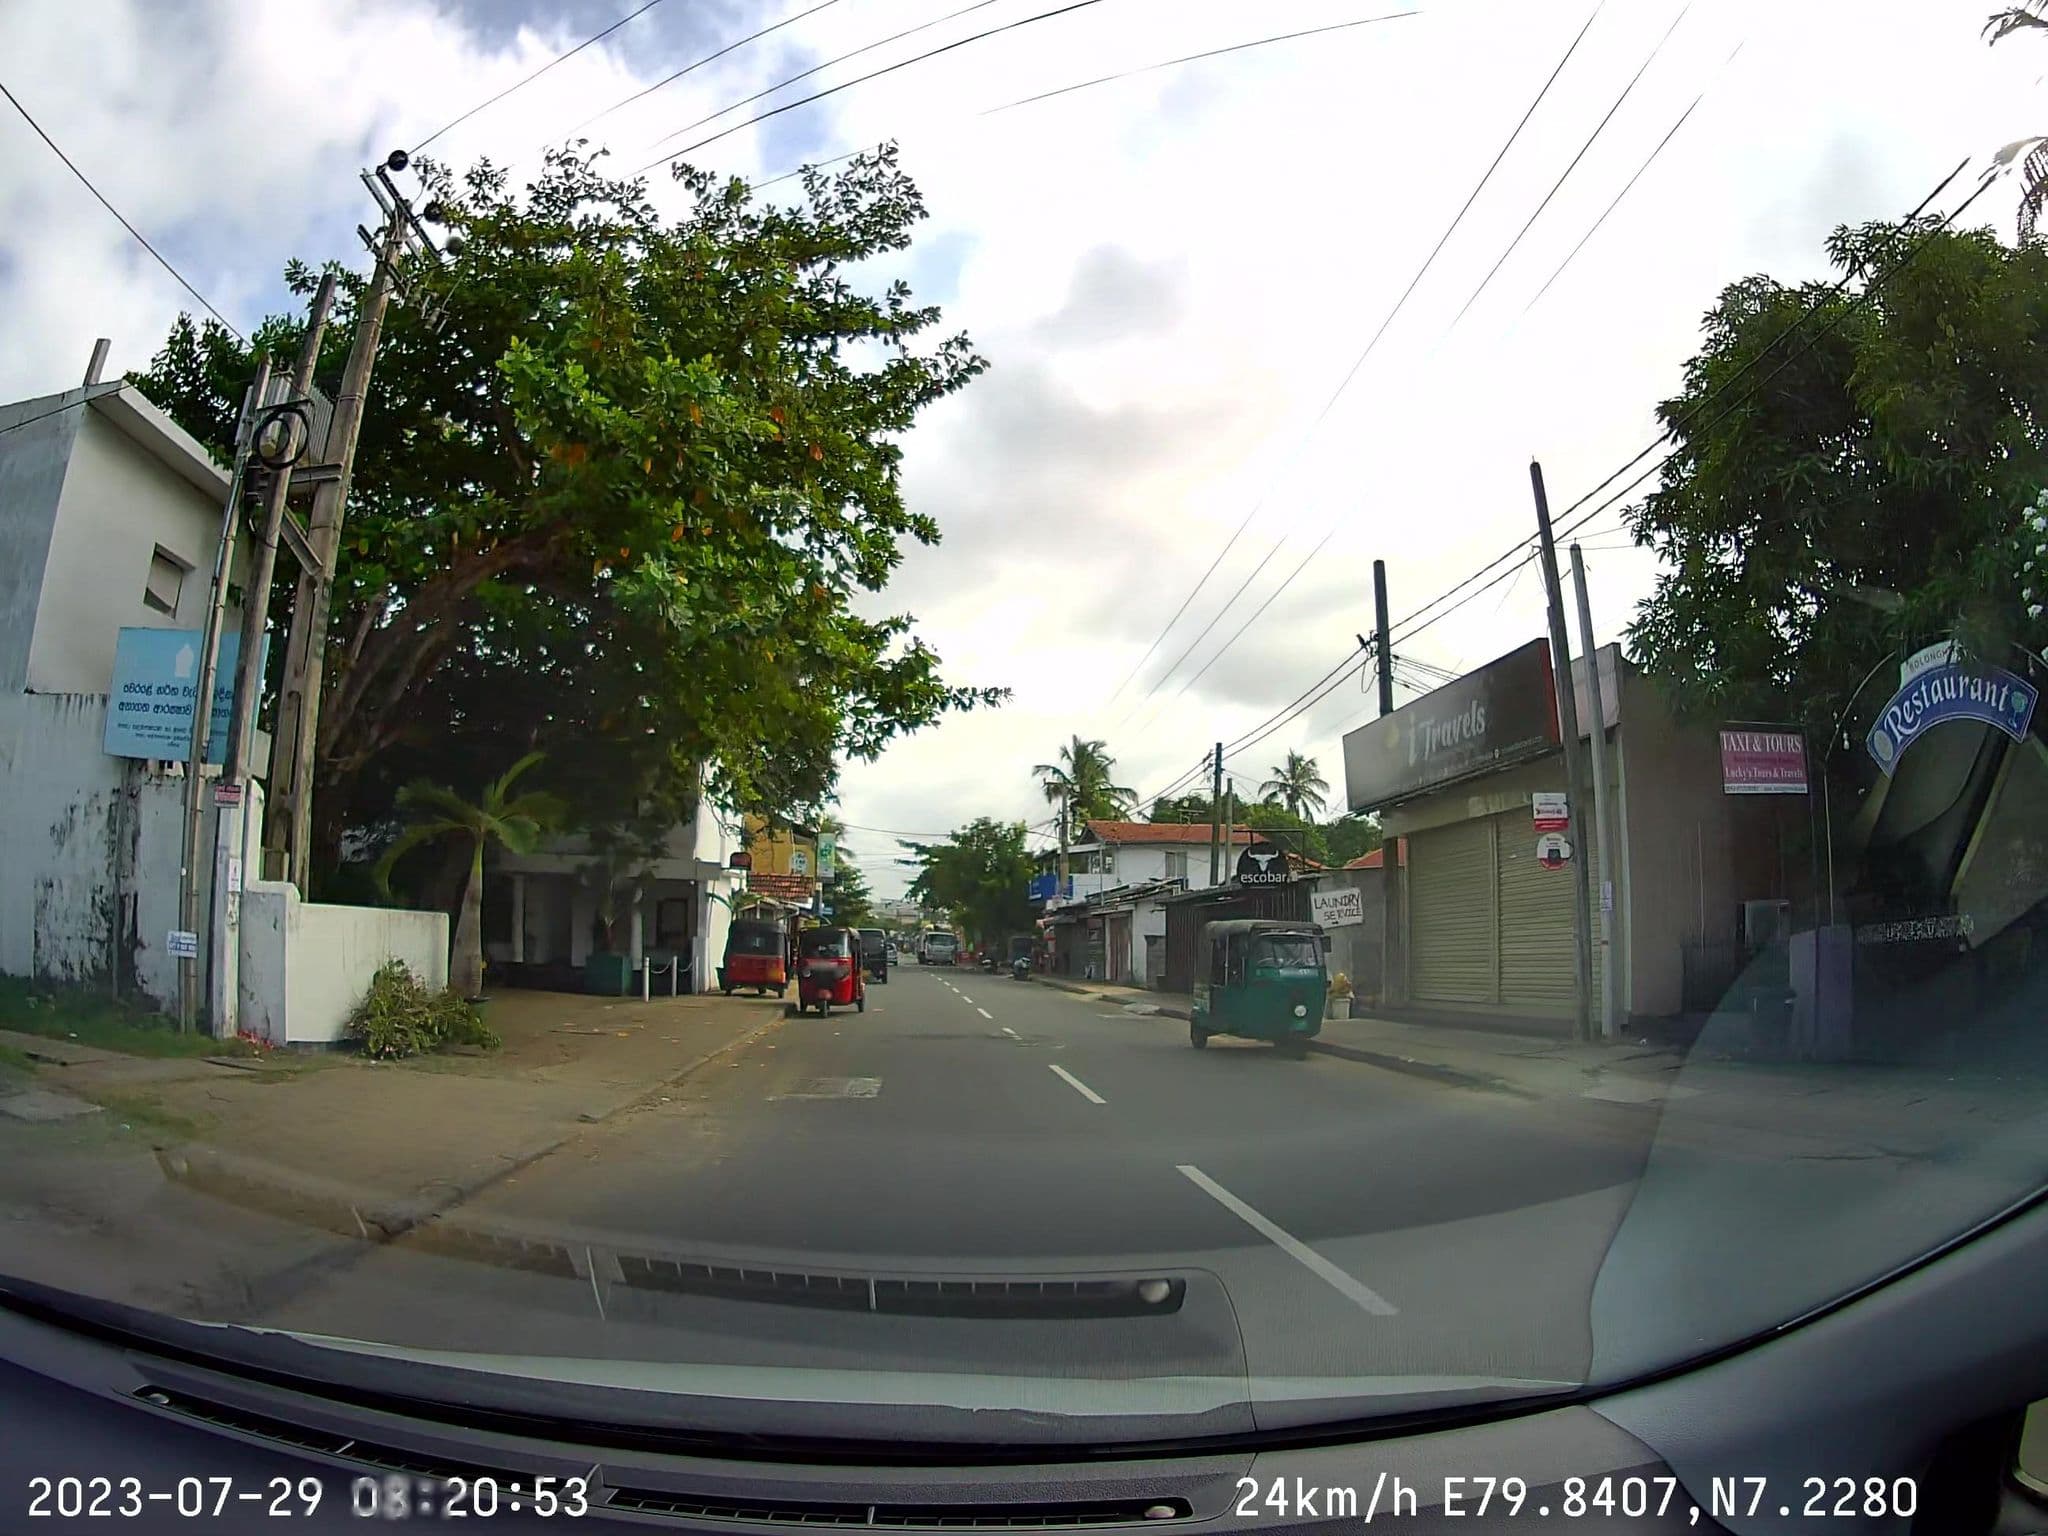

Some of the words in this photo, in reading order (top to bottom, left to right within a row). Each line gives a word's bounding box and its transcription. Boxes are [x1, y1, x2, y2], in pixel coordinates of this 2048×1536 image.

[1884, 676, 2009, 743] Restaurant
[1420, 700, 1487, 761] Travels
[1720, 733, 1751, 752] TAXI
[1752, 735, 1762, 752] &
[1763, 735, 1801, 753] TOURS
[1314, 892, 1360, 909] LAUNDRY
[1323, 908, 1361, 921] SERVICE
